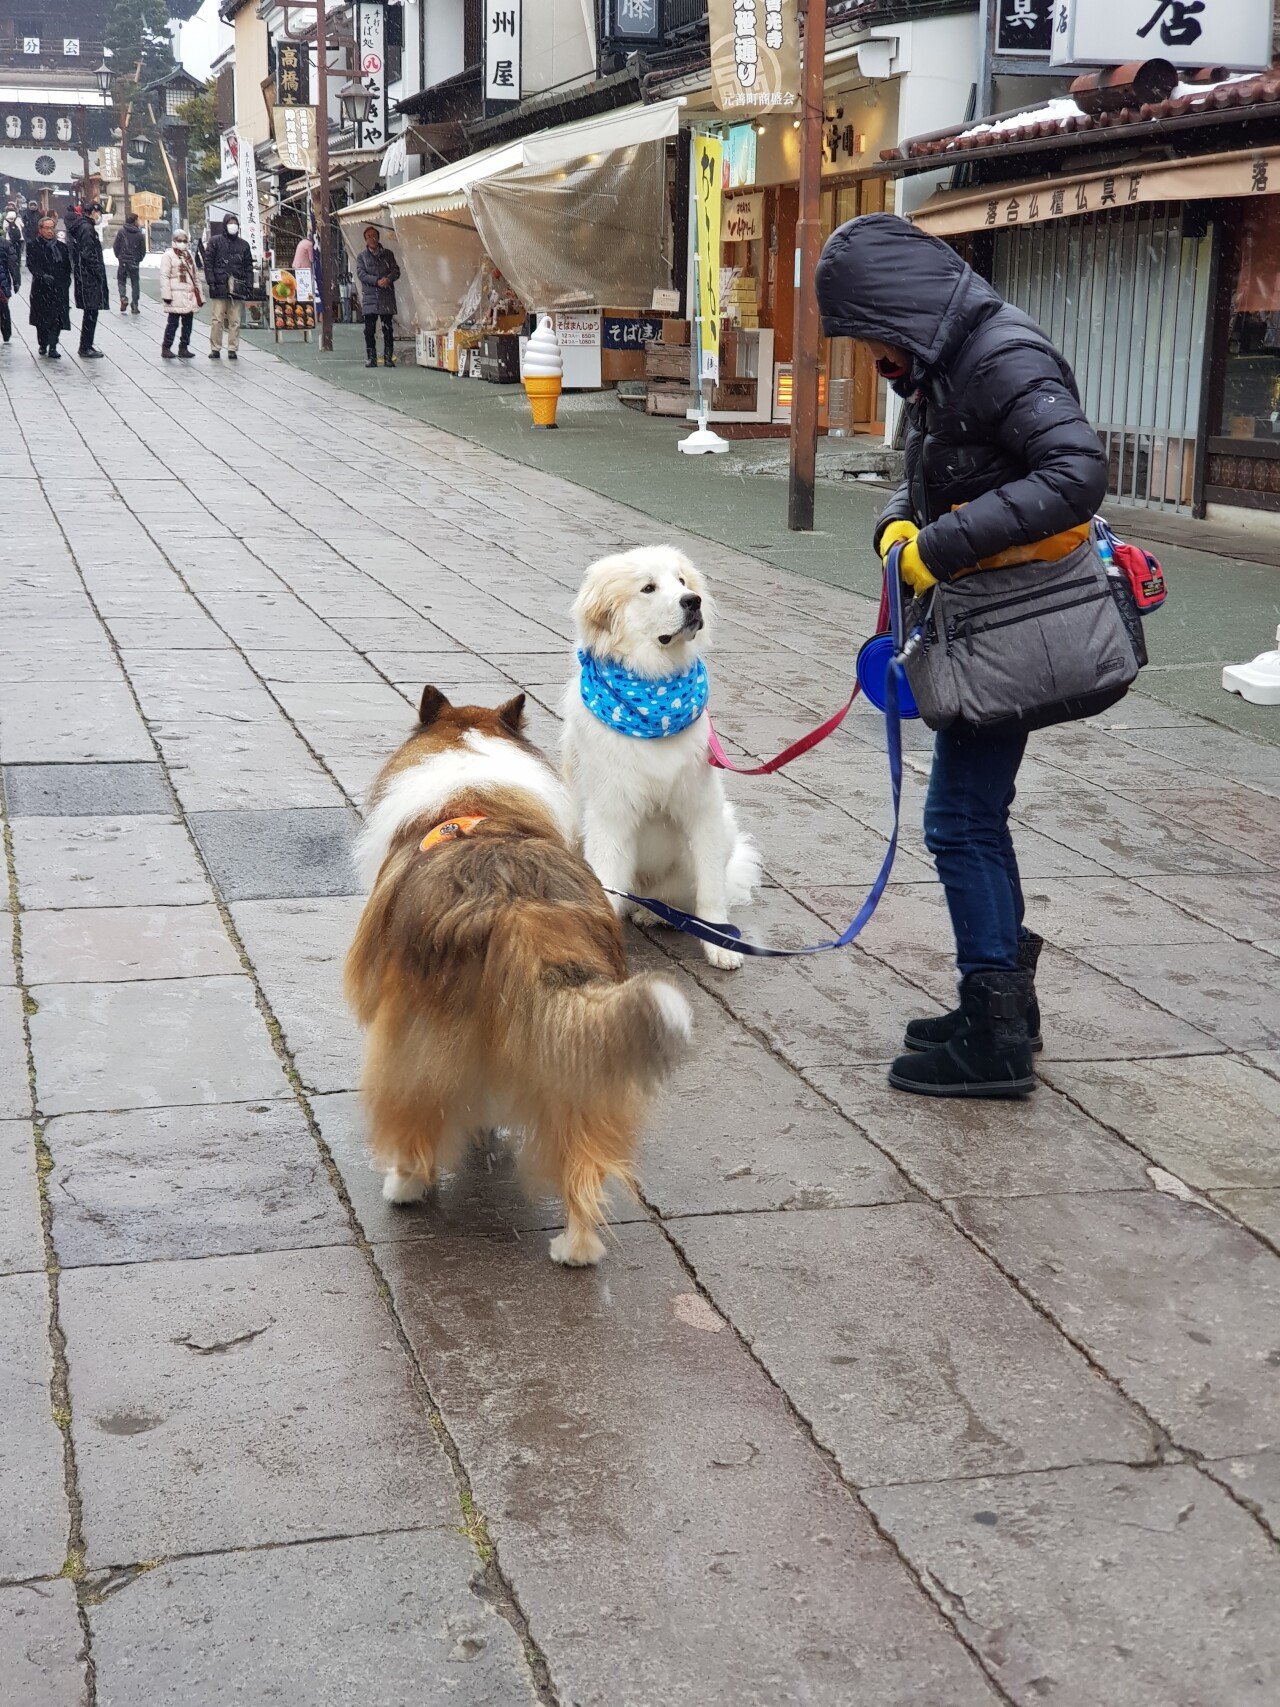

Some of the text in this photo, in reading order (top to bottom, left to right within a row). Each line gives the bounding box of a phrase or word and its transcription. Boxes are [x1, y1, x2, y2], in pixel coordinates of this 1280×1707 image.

[363, 14, 374, 48] そば処
[492, 10, 515, 87] 州屋
[557, 321, 599, 330] そばまんじゅう
